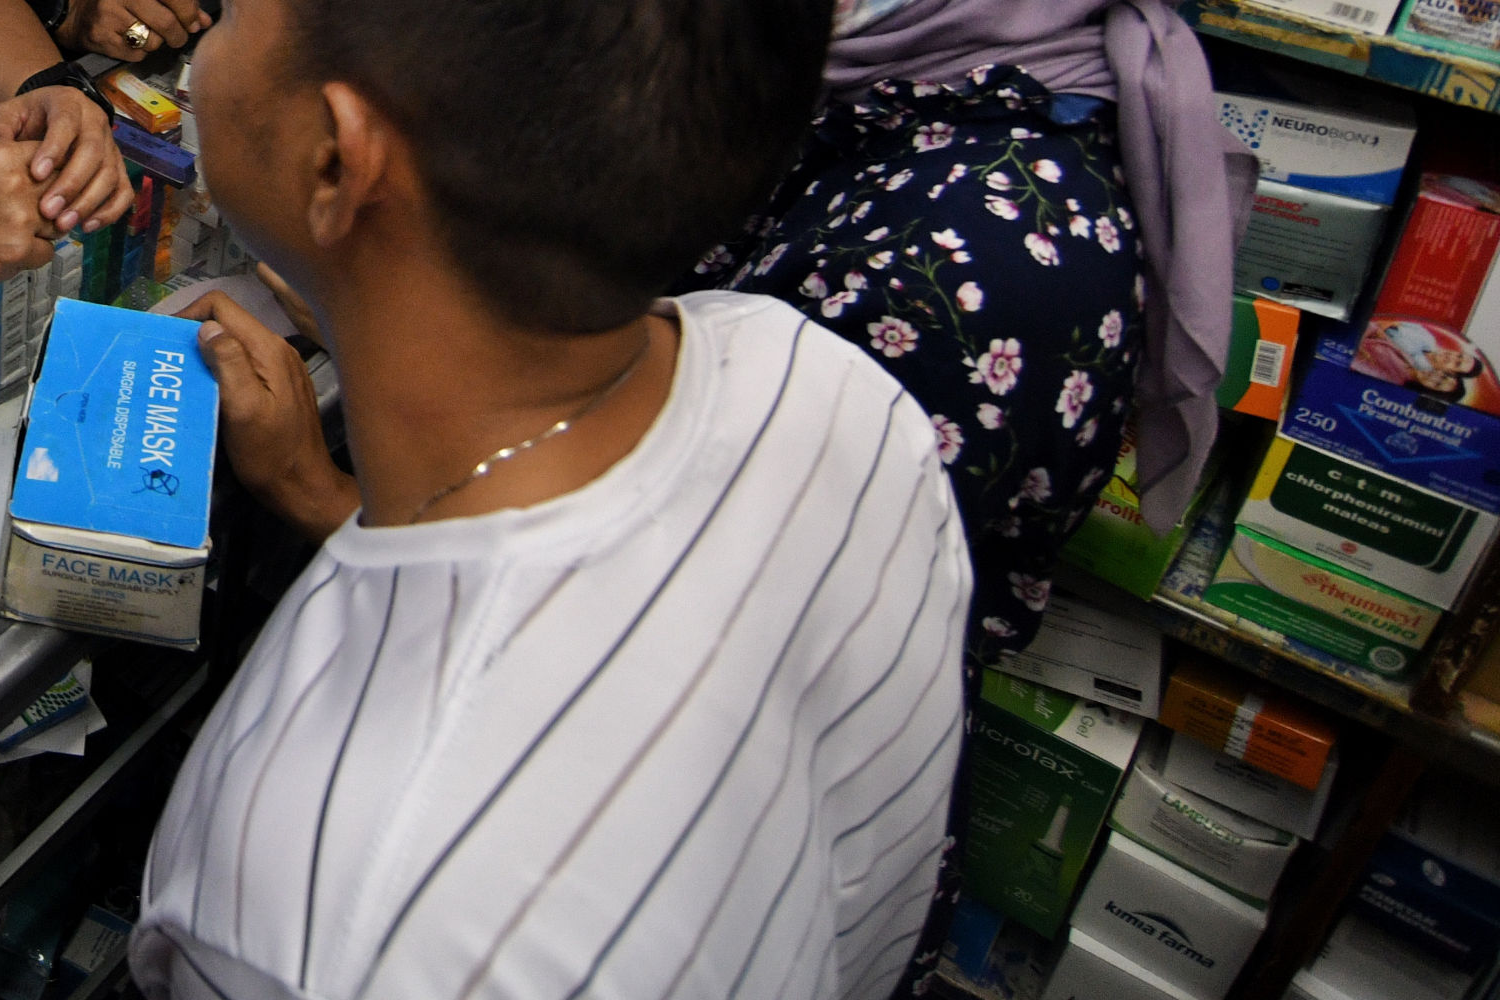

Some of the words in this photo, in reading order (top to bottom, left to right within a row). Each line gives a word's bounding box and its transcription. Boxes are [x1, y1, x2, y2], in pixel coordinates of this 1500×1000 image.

[1271, 115, 1371, 146] NEUROBION
[115, 360, 136, 410] SURGICAL
[148, 348, 185, 402] FACE
[139, 404, 179, 468] MASK
[1293, 406, 1338, 433] 250
[1357, 402, 1410, 432] Pirantel
[1361, 387, 1474, 440] Combantrin
[105, 411, 130, 471] DISPOSABLE
[1284, 468, 1446, 539] chlorpheniramini
[1321, 500, 1391, 536] maleas
[41, 553, 101, 578] FACE
[108, 565, 174, 588] MASK
[1342, 606, 1418, 641] NEURO
[973, 720, 1075, 782] icrolax
[1104, 900, 1157, 937] kimia
[1154, 928, 1216, 971] farma
